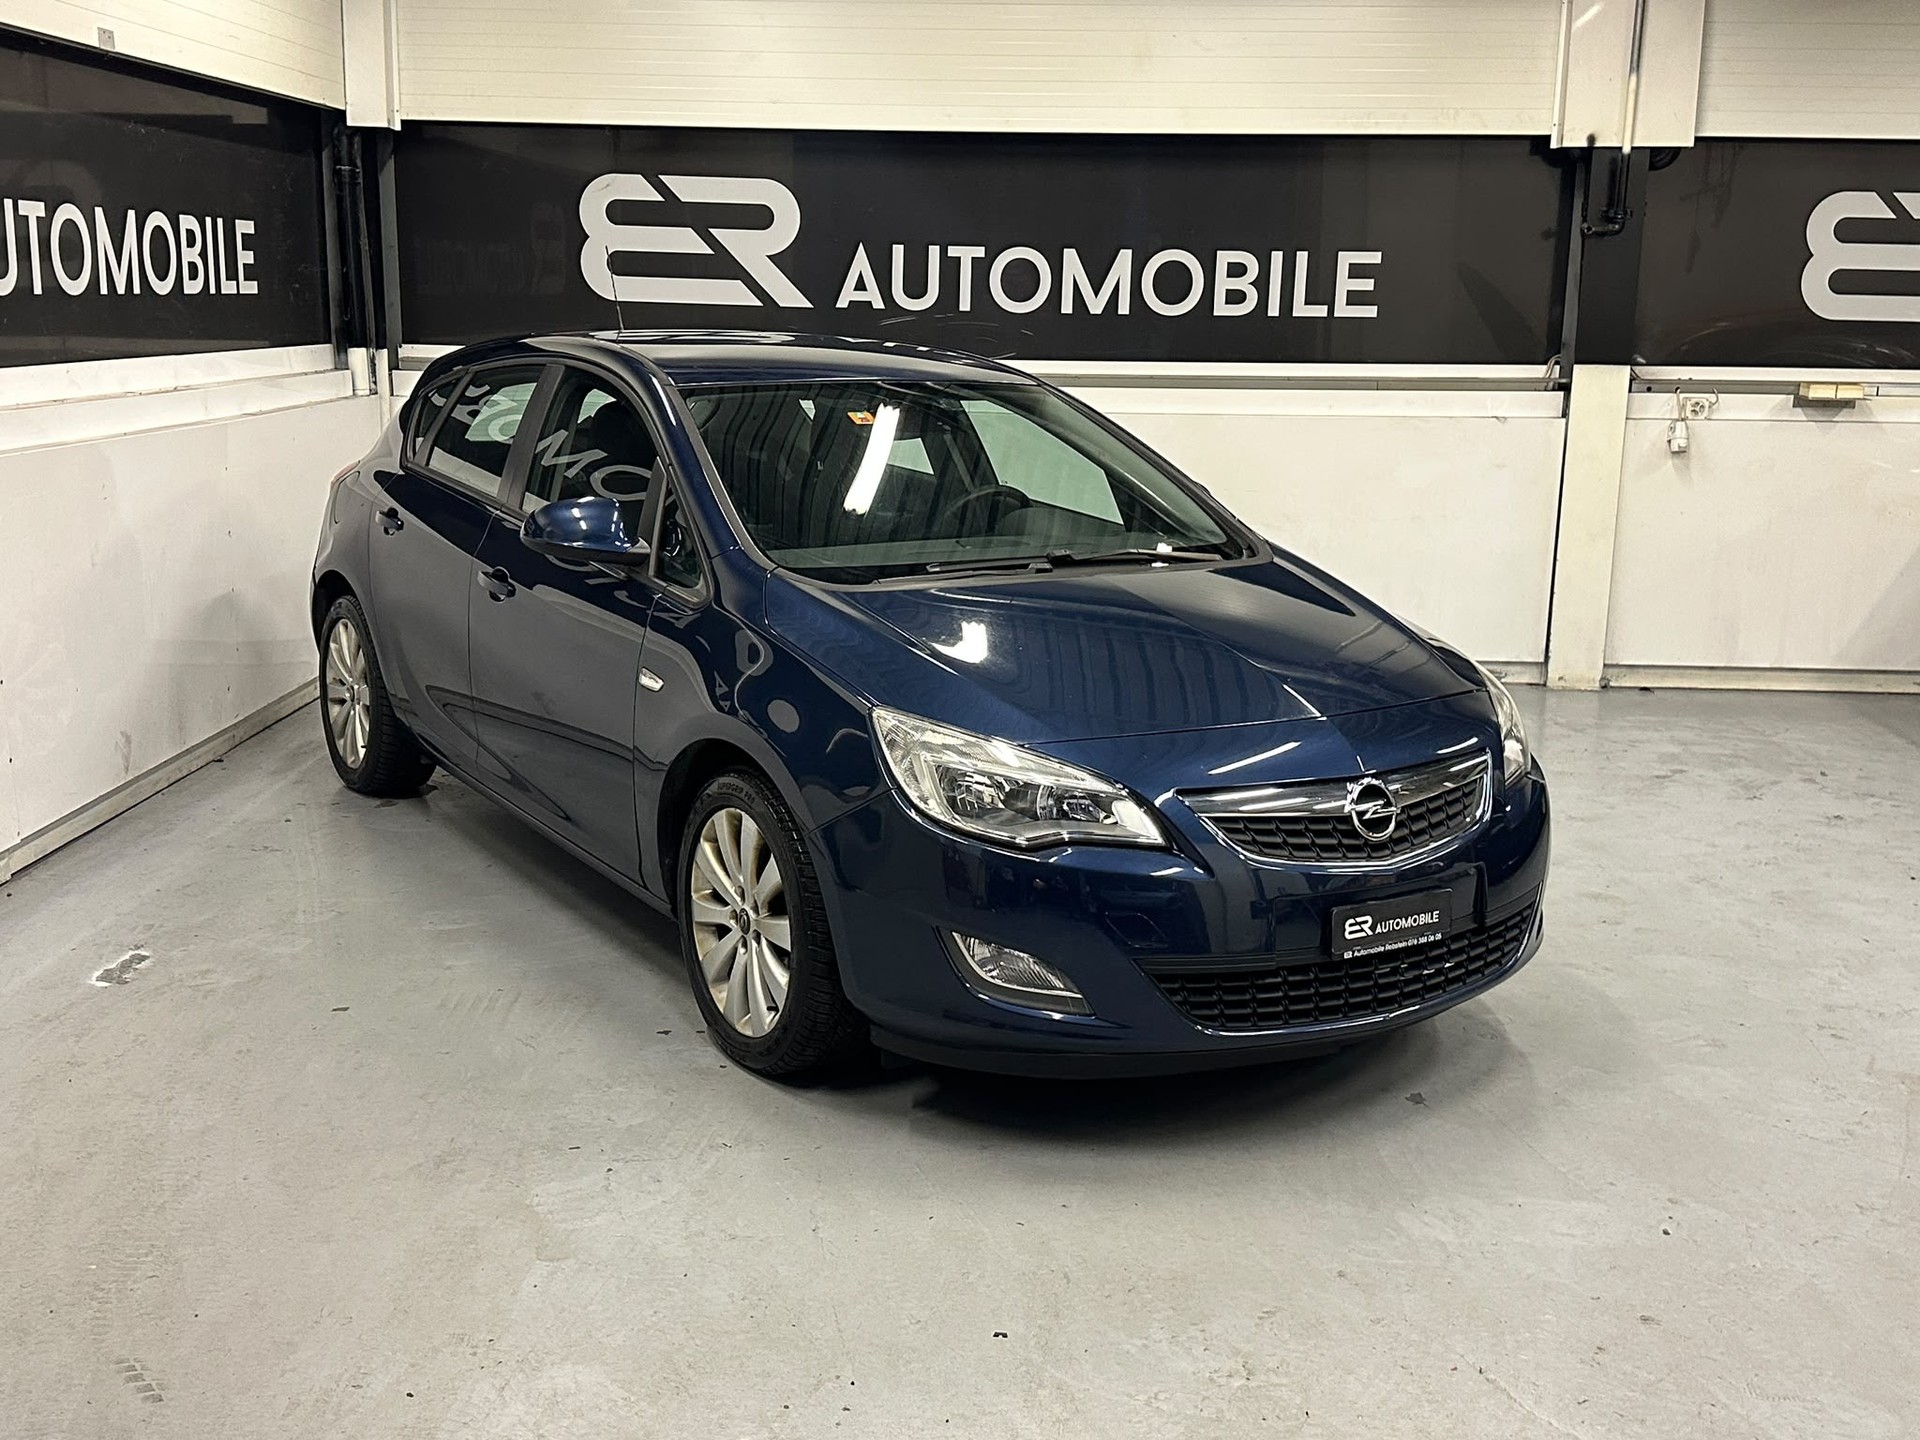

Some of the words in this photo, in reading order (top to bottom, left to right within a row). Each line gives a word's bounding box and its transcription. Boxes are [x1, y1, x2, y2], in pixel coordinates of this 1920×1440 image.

[835, 243, 1383, 318] AUTOMOBILE
[1375, 910, 1440, 936] AUTOMOBILE
[1354, 945, 1384, 957] Automobile
